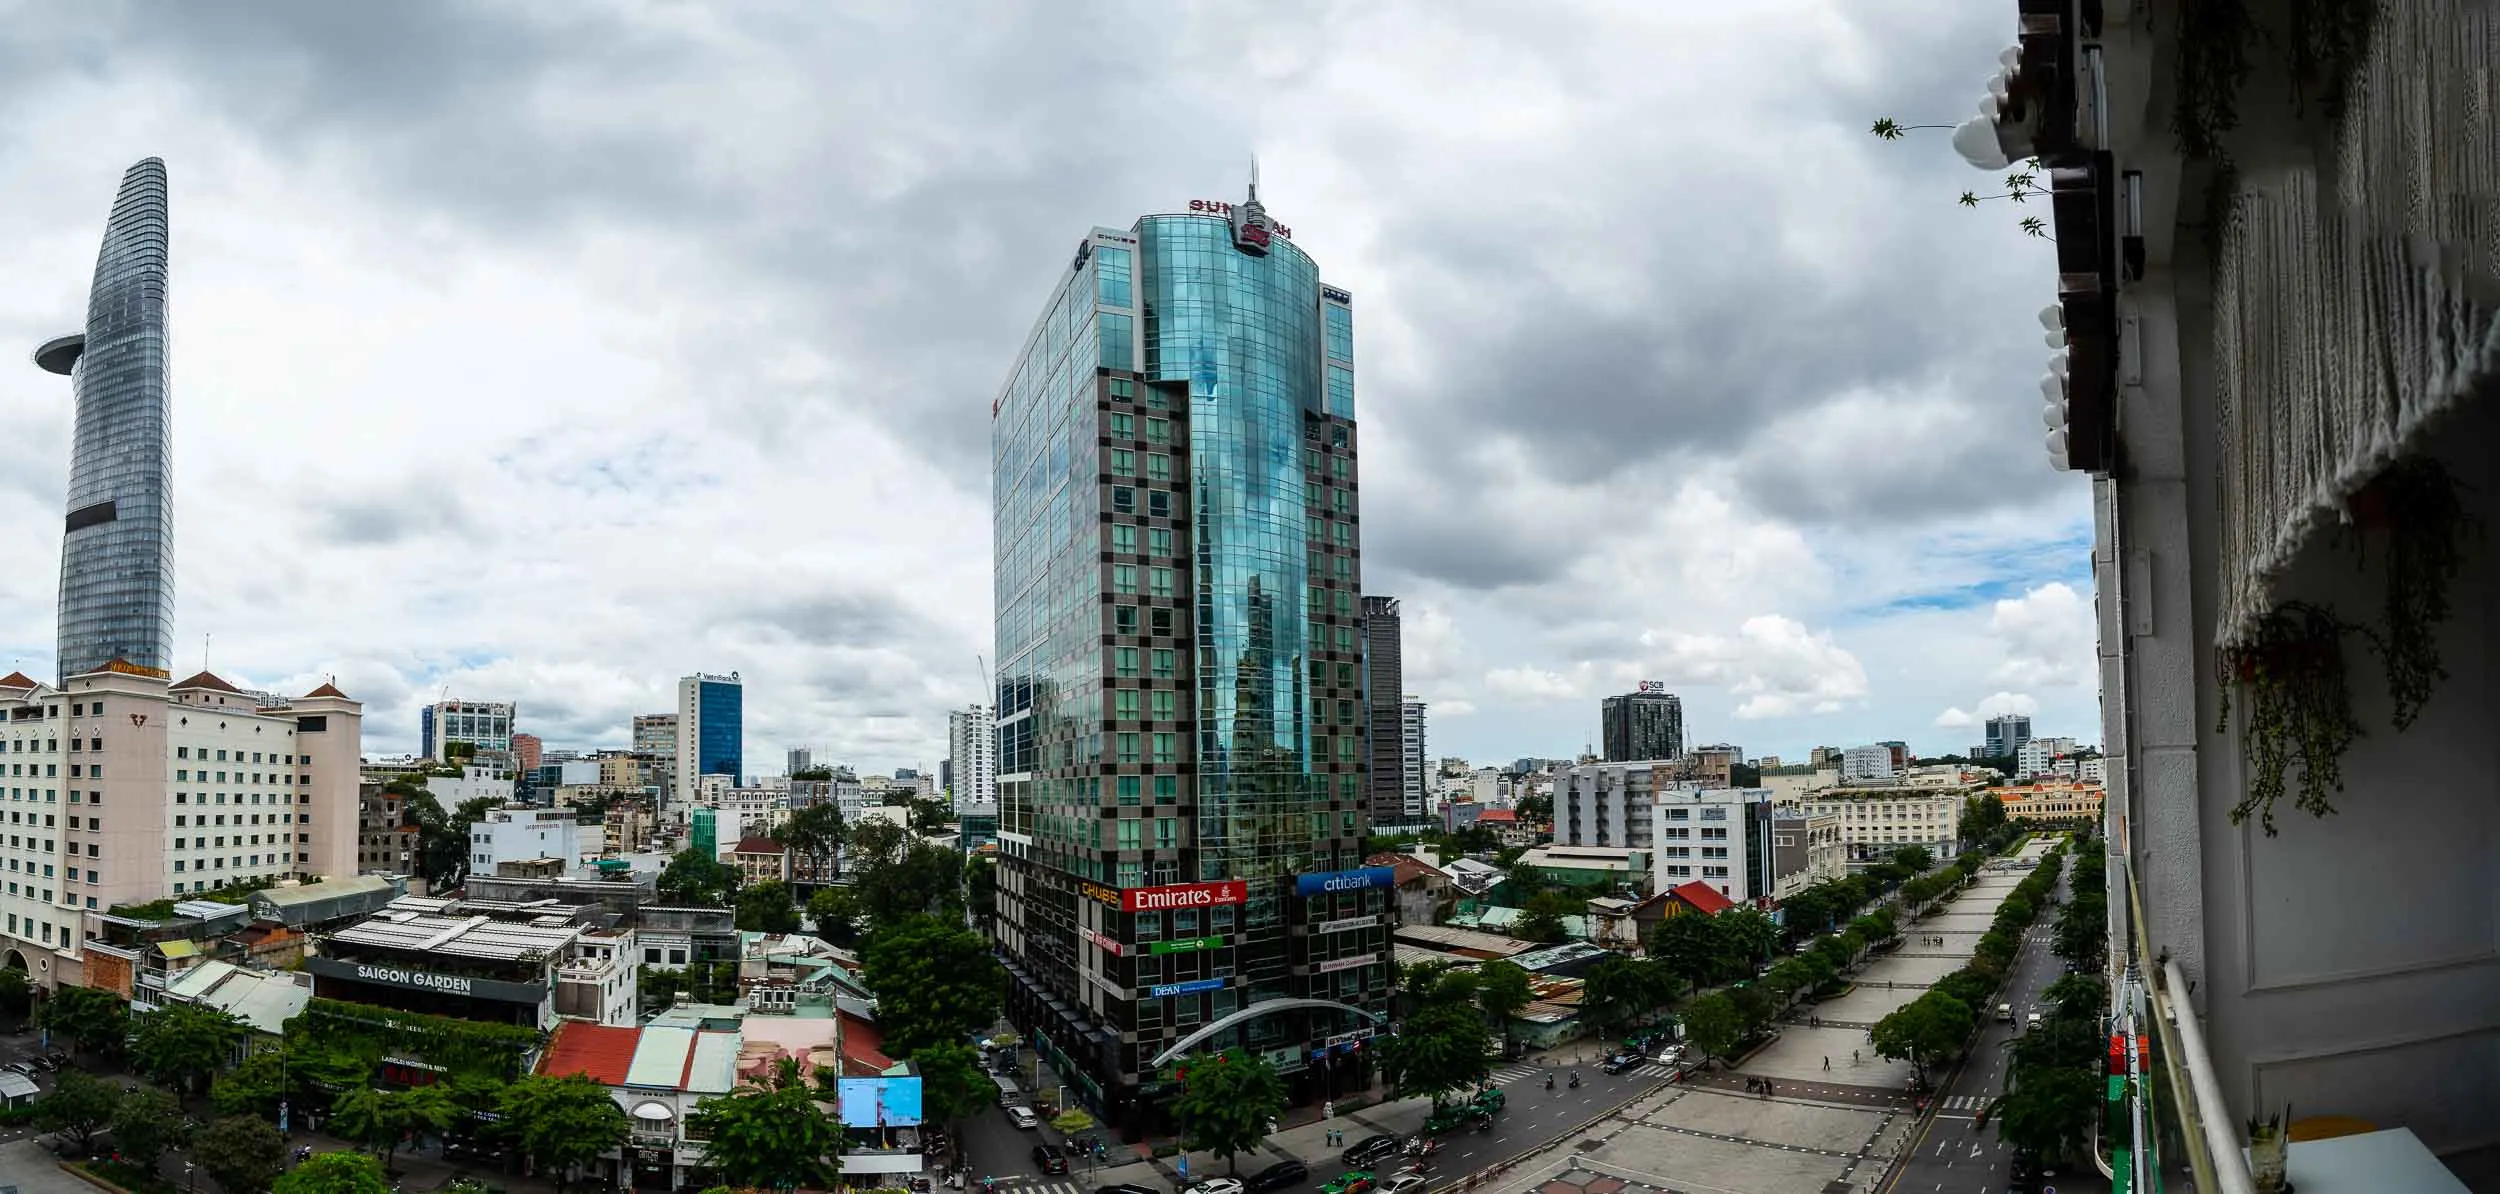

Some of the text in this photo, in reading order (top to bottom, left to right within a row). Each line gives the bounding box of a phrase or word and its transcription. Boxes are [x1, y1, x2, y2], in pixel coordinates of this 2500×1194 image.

[1323, 873, 1372, 891] citibank
[1081, 881, 1119, 905] CHUBB
[1135, 888, 1211, 908] Emirates
[357, 965, 471, 991] SAIGON GARDEN
[433, 1064, 448, 1073] MEN
